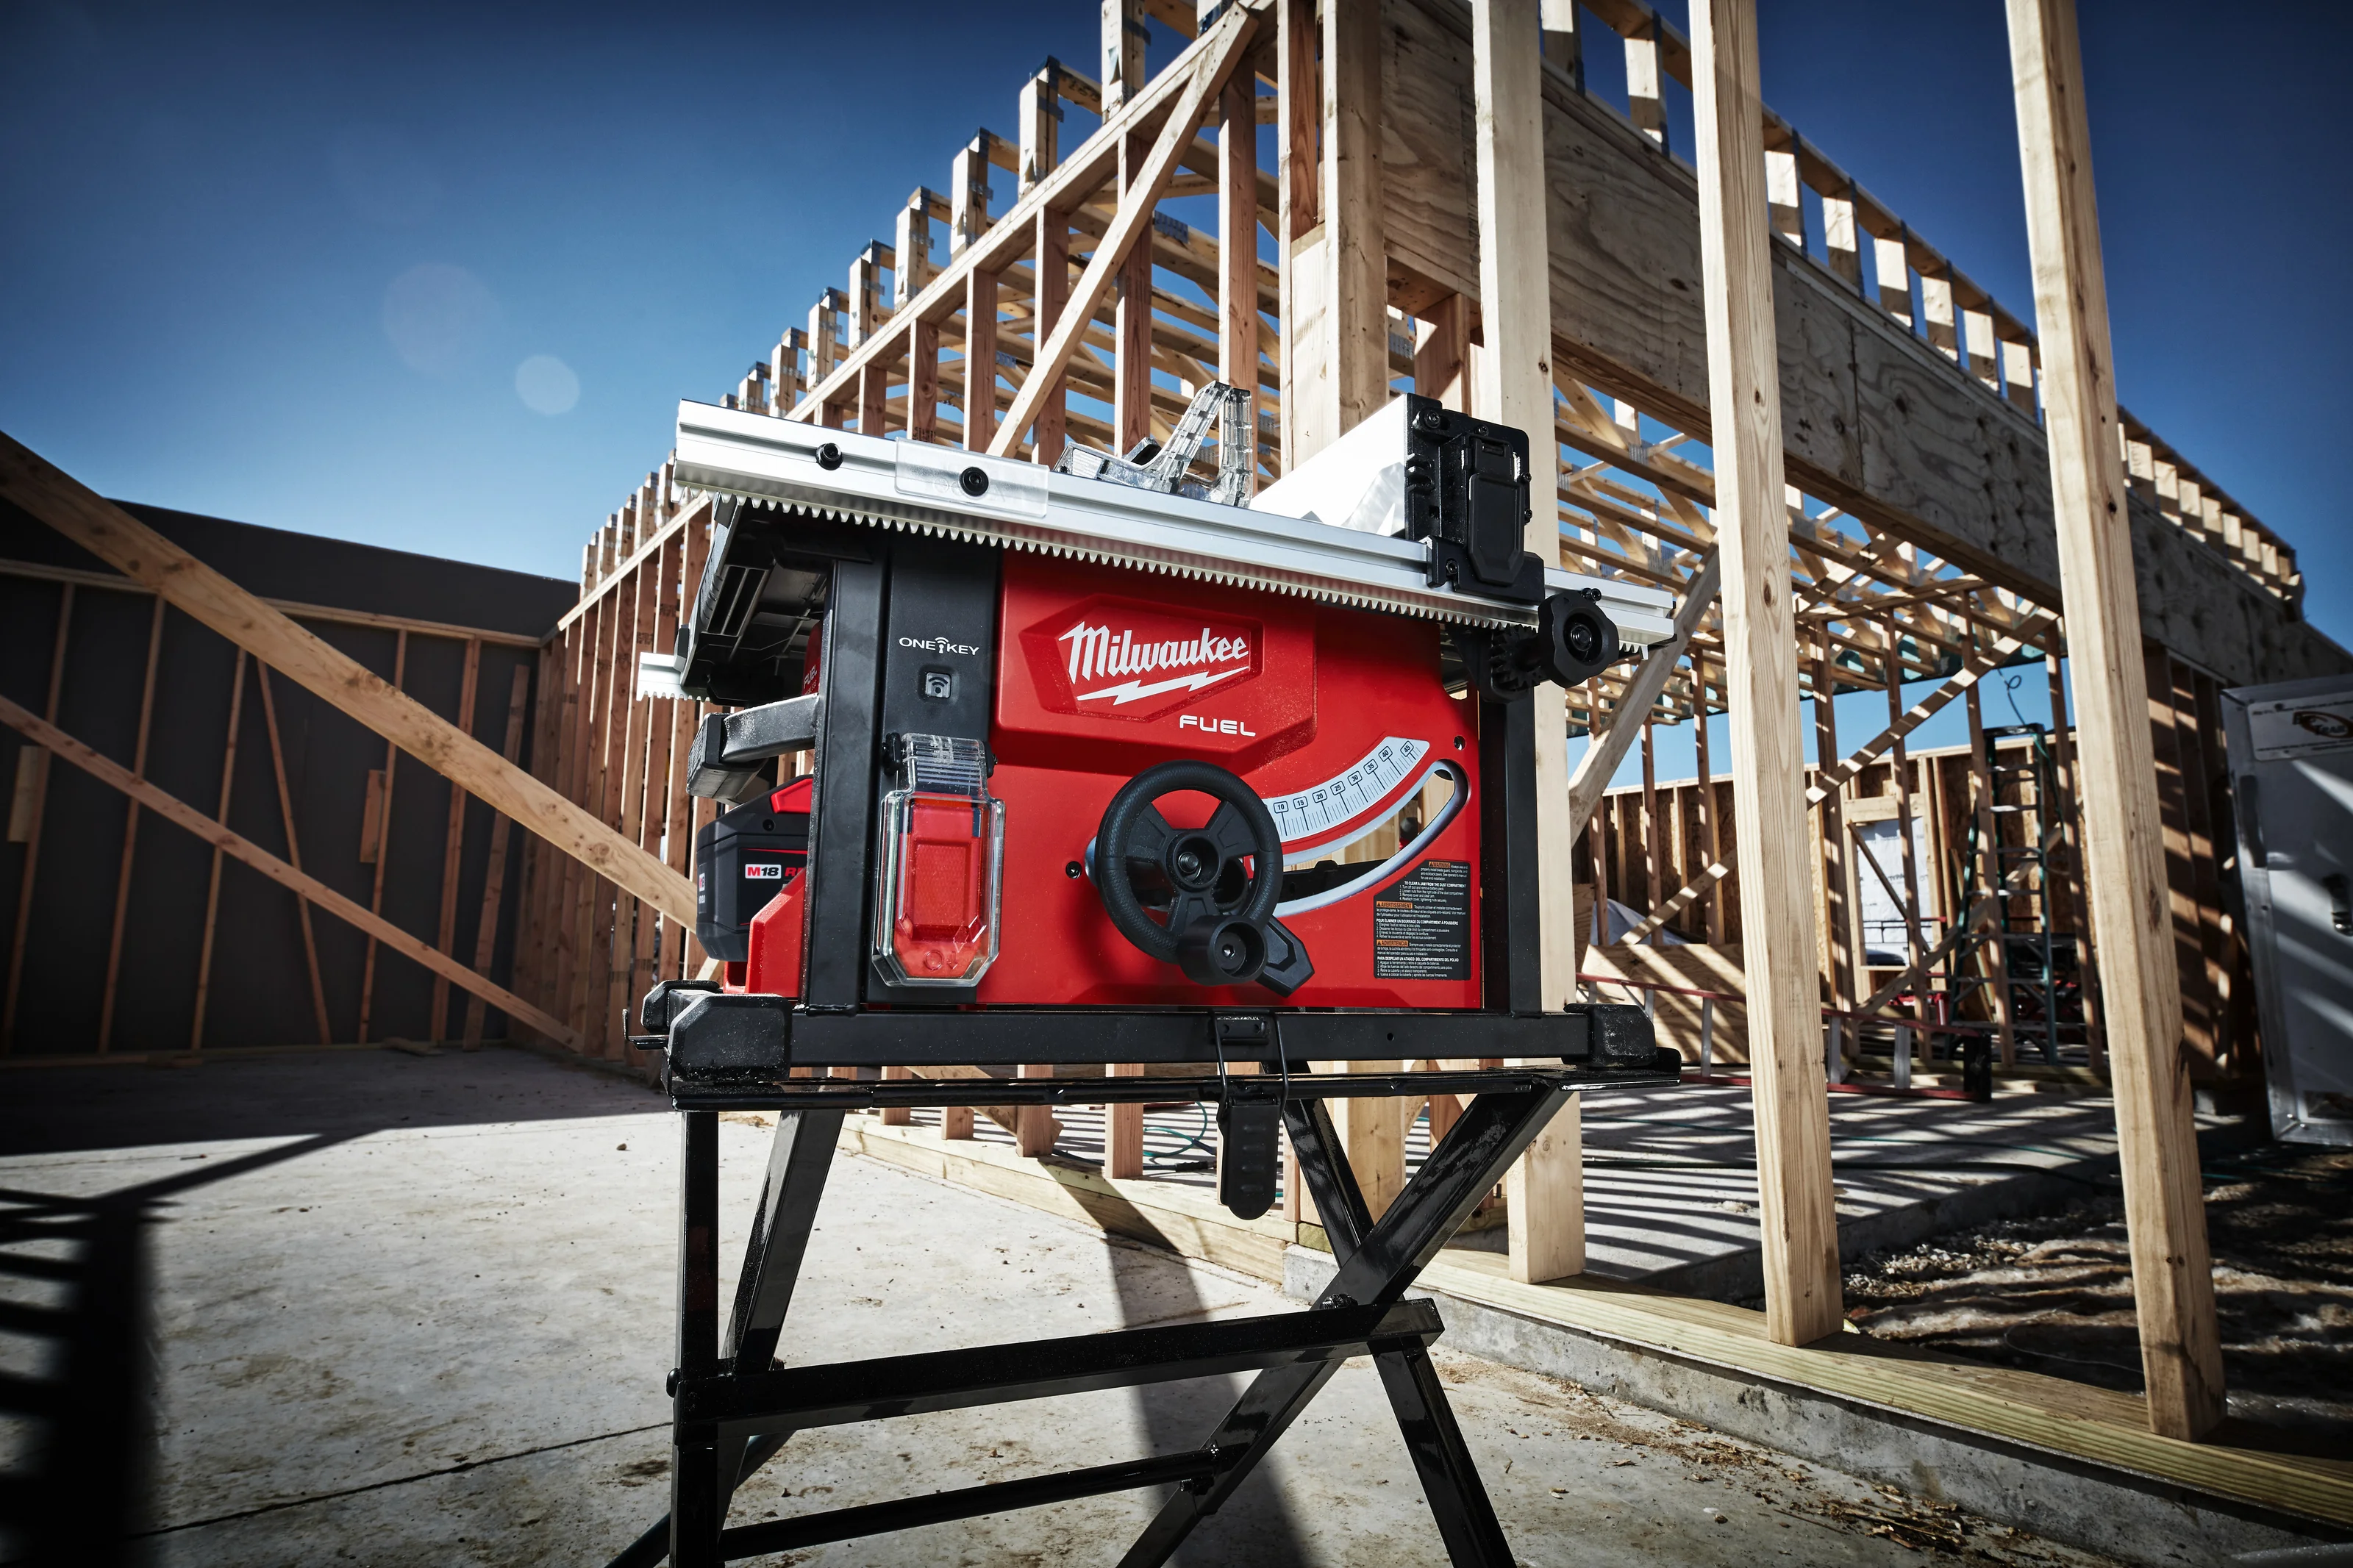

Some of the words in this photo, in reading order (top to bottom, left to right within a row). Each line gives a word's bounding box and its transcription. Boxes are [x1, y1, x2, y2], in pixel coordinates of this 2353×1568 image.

[1059, 621, 1249, 684] Milwaukee
[1179, 715, 1256, 737] FUEL
[1351, 774, 1359, 782] 30
[1367, 762, 1374, 770] 35
[1382, 750, 1389, 758] 40
[1404, 744, 1411, 753] 45
[747, 867, 779, 876] M18
